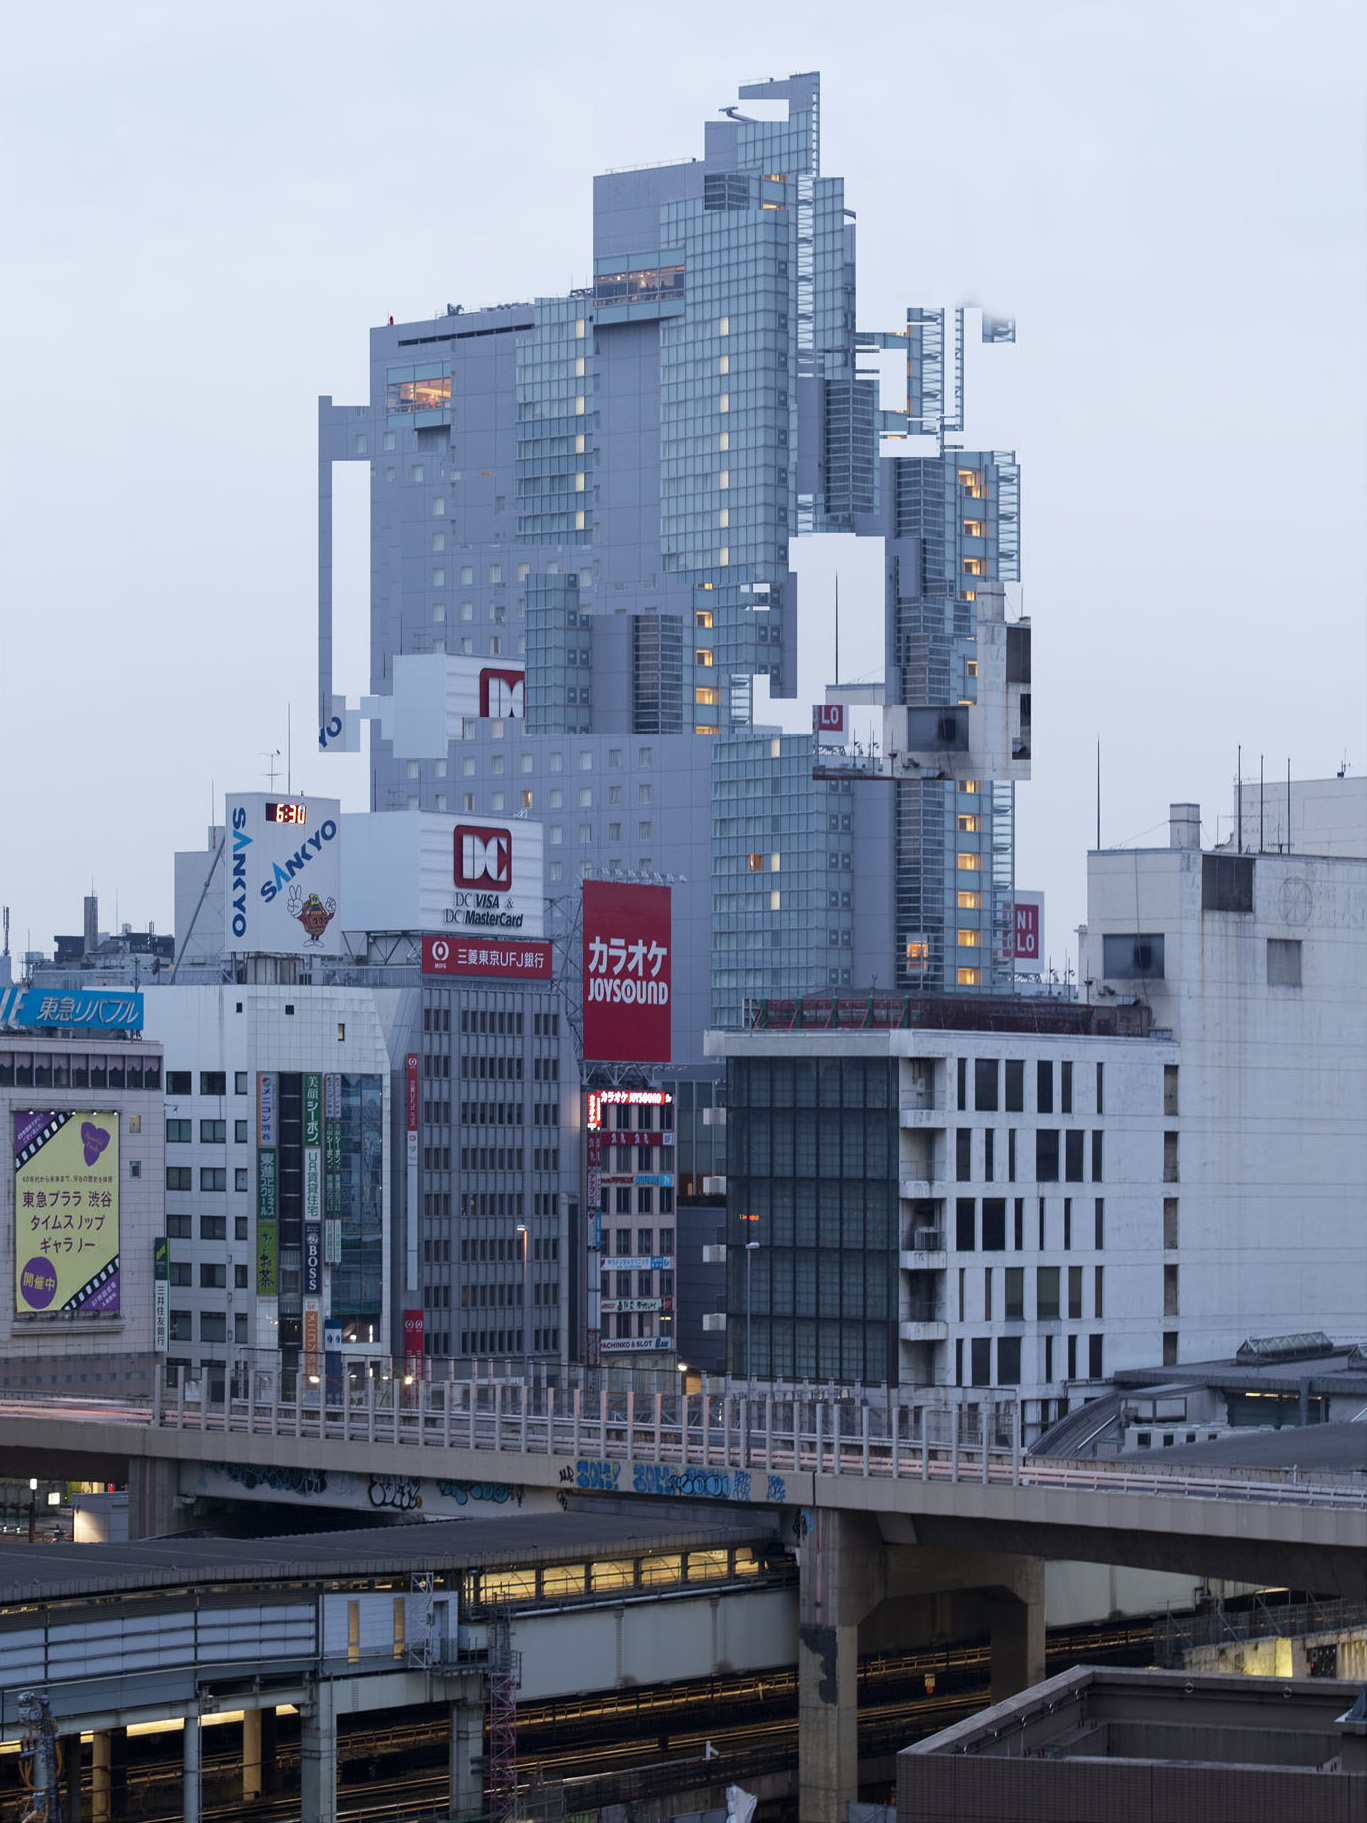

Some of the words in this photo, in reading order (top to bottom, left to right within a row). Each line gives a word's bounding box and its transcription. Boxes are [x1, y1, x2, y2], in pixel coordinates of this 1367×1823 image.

[276, 803, 305, 825] 6:30
[260, 820, 337, 903] SANKYO
[462, 834, 508, 882] DC
[232, 807, 253, 938] SANKYO
[455, 892, 472, 908] DC
[475, 893, 500, 909] VISA
[505, 898, 514, 909] &
[445, 908, 463, 924] DC
[465, 910, 524, 928] MasterCard
[1017, 911, 1033, 931] NI
[1017, 932, 1035, 952] LO
[457, 948, 544, 969] 三菱東京UFJ銀行
[588, 936, 667, 978] カラオケ
[588, 978, 668, 1006] JOYSOUND
[600, 1091, 628, 1103] カラオケ
[262, 1088, 272, 1141] メニコン渋谷
[307, 1152, 319, 1217] UR賃貸住宅
[88, 1190, 112, 1208] 渋谷
[308, 1245, 318, 1291] BOSS
[23, 1271, 56, 1292] 開催中
[157, 1285, 165, 1346] 三井住友銀行
[636, 1339, 653, 1348] SLOT
